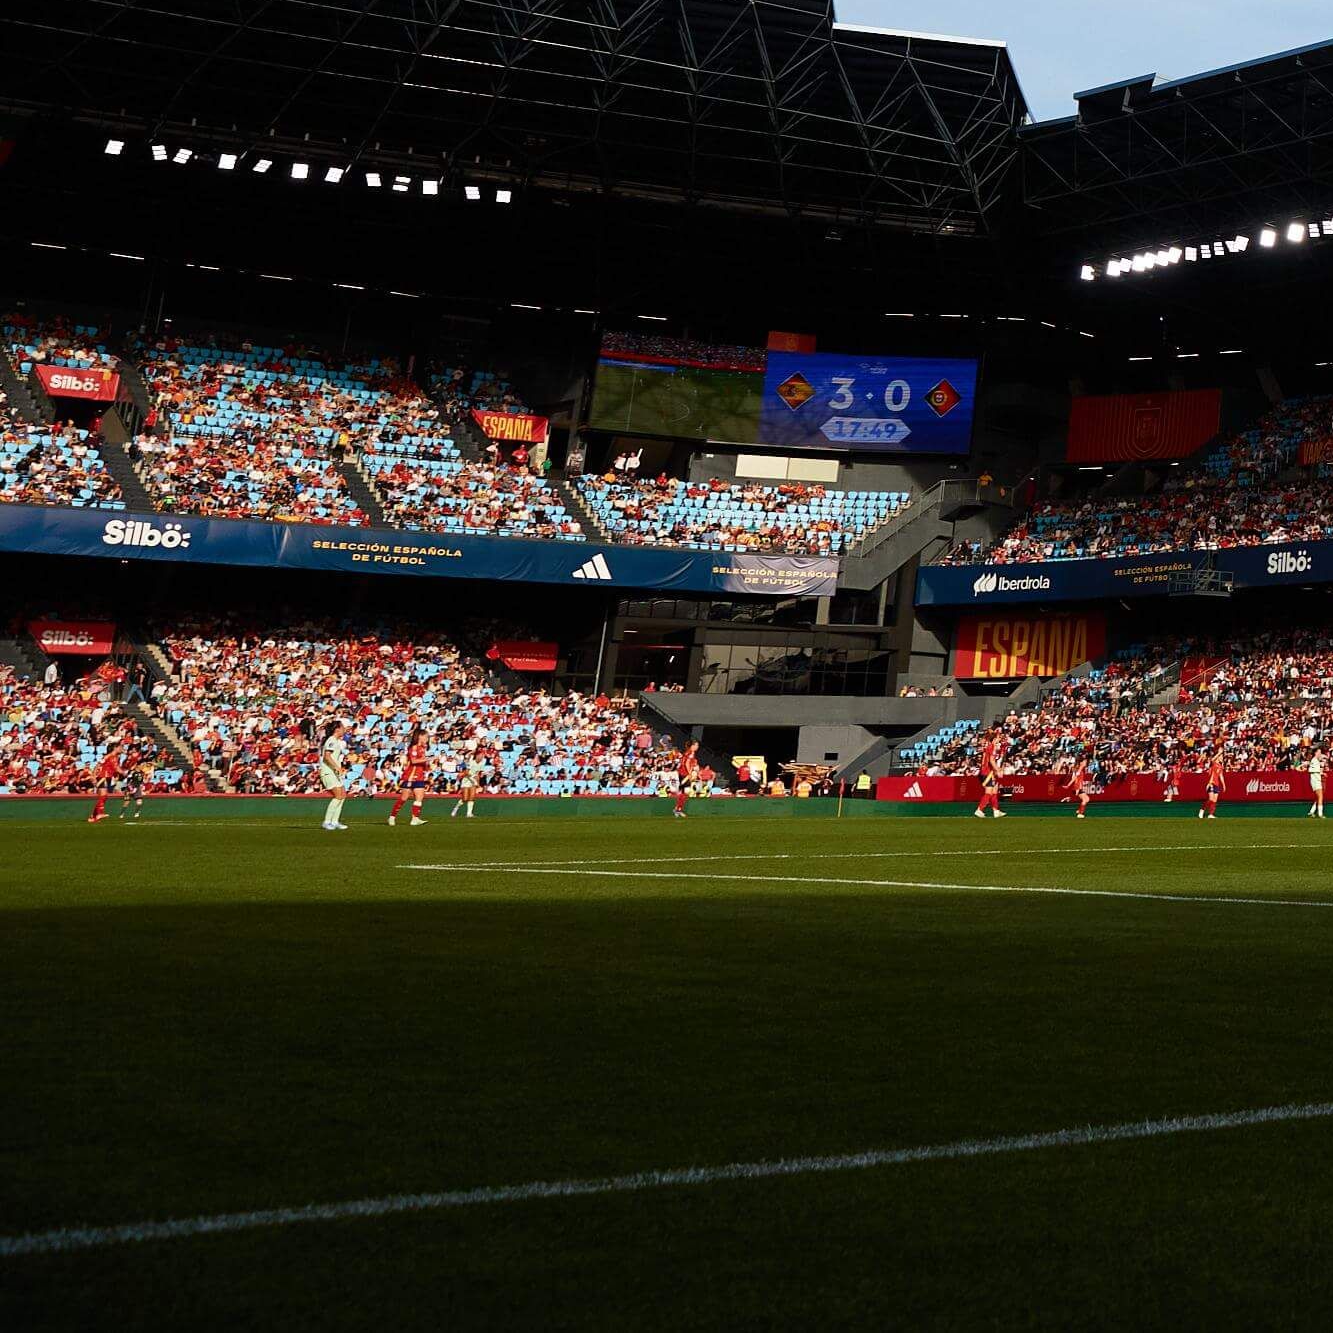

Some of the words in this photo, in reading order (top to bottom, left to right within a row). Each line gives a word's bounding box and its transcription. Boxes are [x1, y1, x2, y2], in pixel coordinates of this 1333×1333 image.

[828, 377, 856, 410] 3
[885, 379, 912, 413] 0
[833, 420, 898, 439] 17:49
[102, 519, 183, 548] Silbö
[312, 540, 390, 553] SELECCIÓN
[393, 545, 463, 557] ESPAÑOLA
[352, 554, 370, 562] DE
[374, 553, 426, 565] FÚTBOL
[1267, 550, 1307, 574] Silbö
[712, 566, 775, 576] SELECCIÓN
[778, 570, 838, 578] ESPAÑOLA
[1145, 574, 1169, 583] FÚTBO
[998, 575, 1051, 590] Iberdrola
[973, 612, 1088, 678] ESPAÑA
